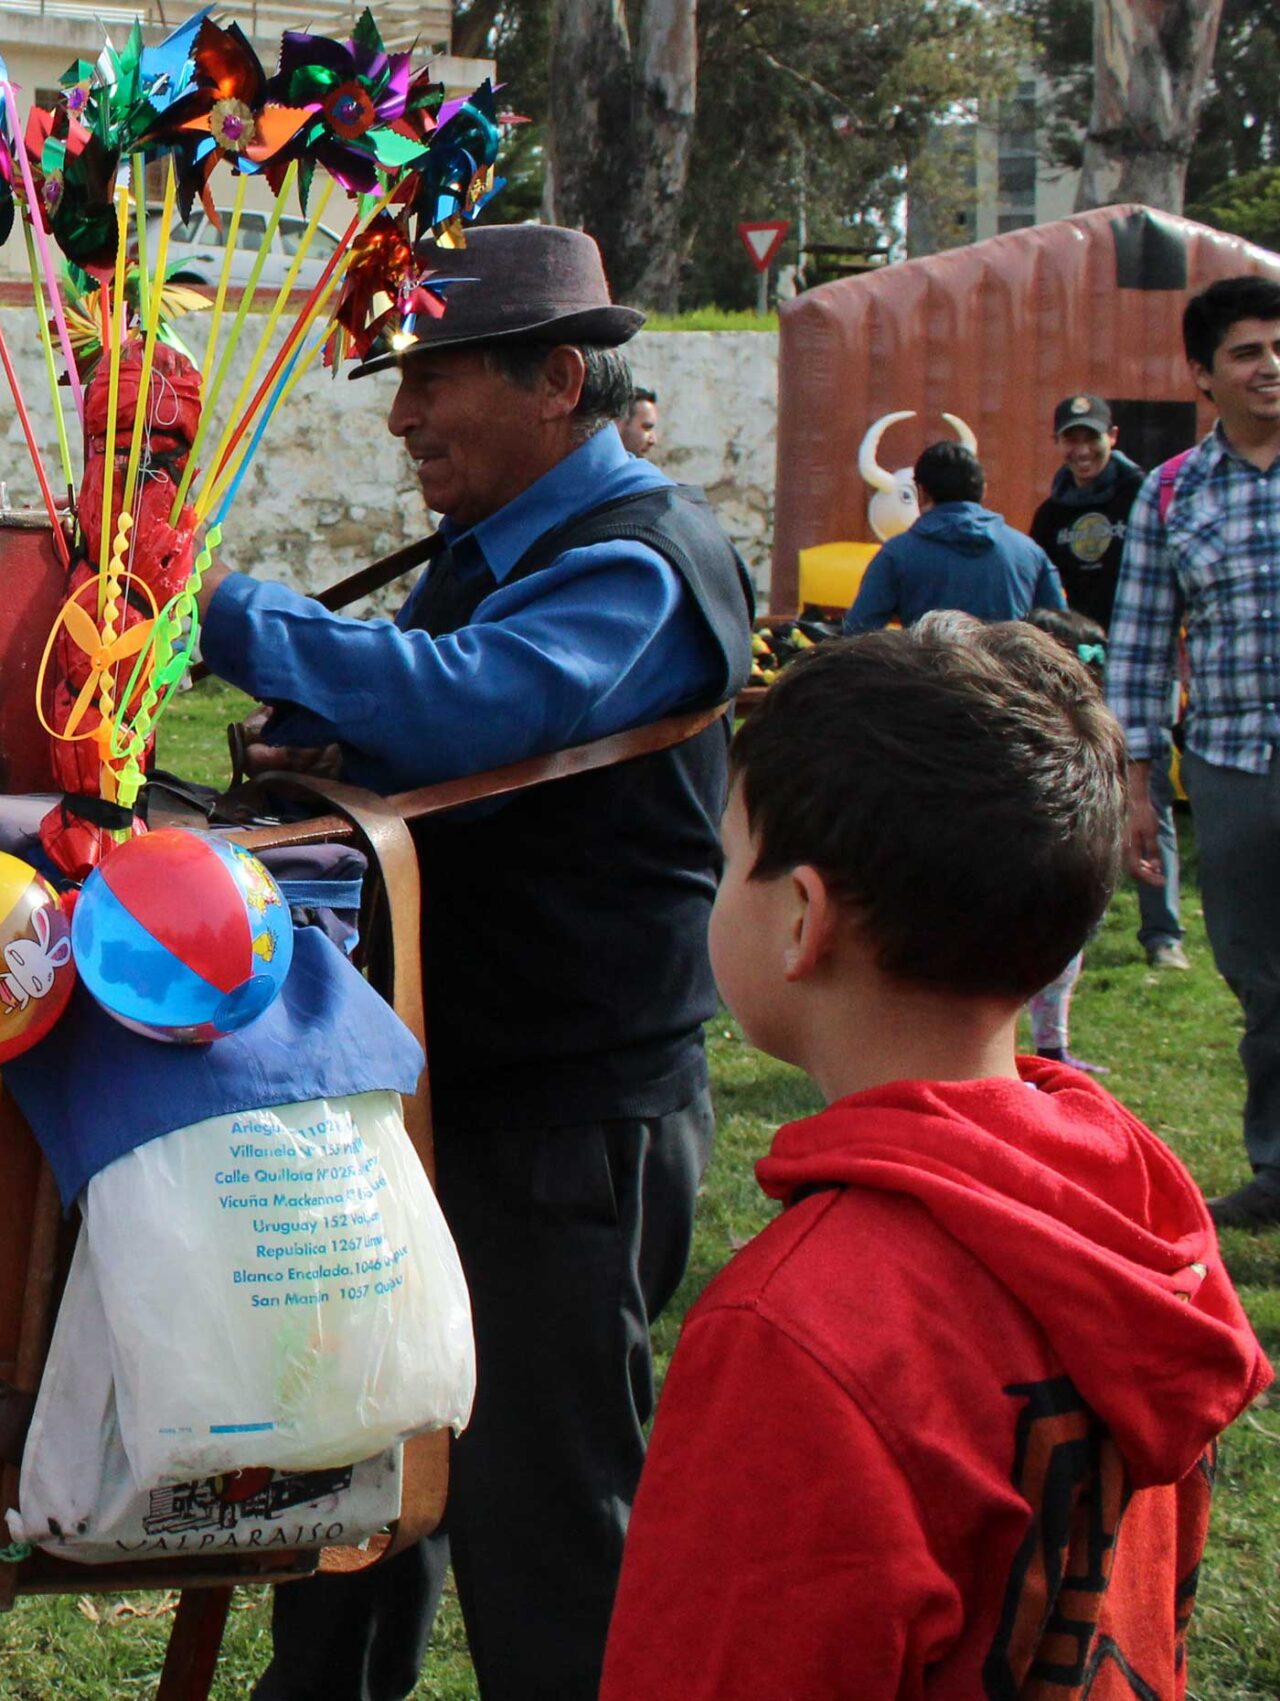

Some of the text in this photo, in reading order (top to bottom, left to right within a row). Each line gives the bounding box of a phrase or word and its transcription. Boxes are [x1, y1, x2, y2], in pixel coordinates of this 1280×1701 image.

[214, 1169, 250, 1184] Calle
[220, 1195, 268, 1209] Vicuña
[253, 1219, 318, 1236] Uruguay
[324, 1214, 348, 1229] 152
[331, 1236, 363, 1253] 1267
[233, 1269, 284, 1284] Blanco
[251, 1293, 280, 1307] San
[116, 1521, 345, 1551] VALPARAISO
